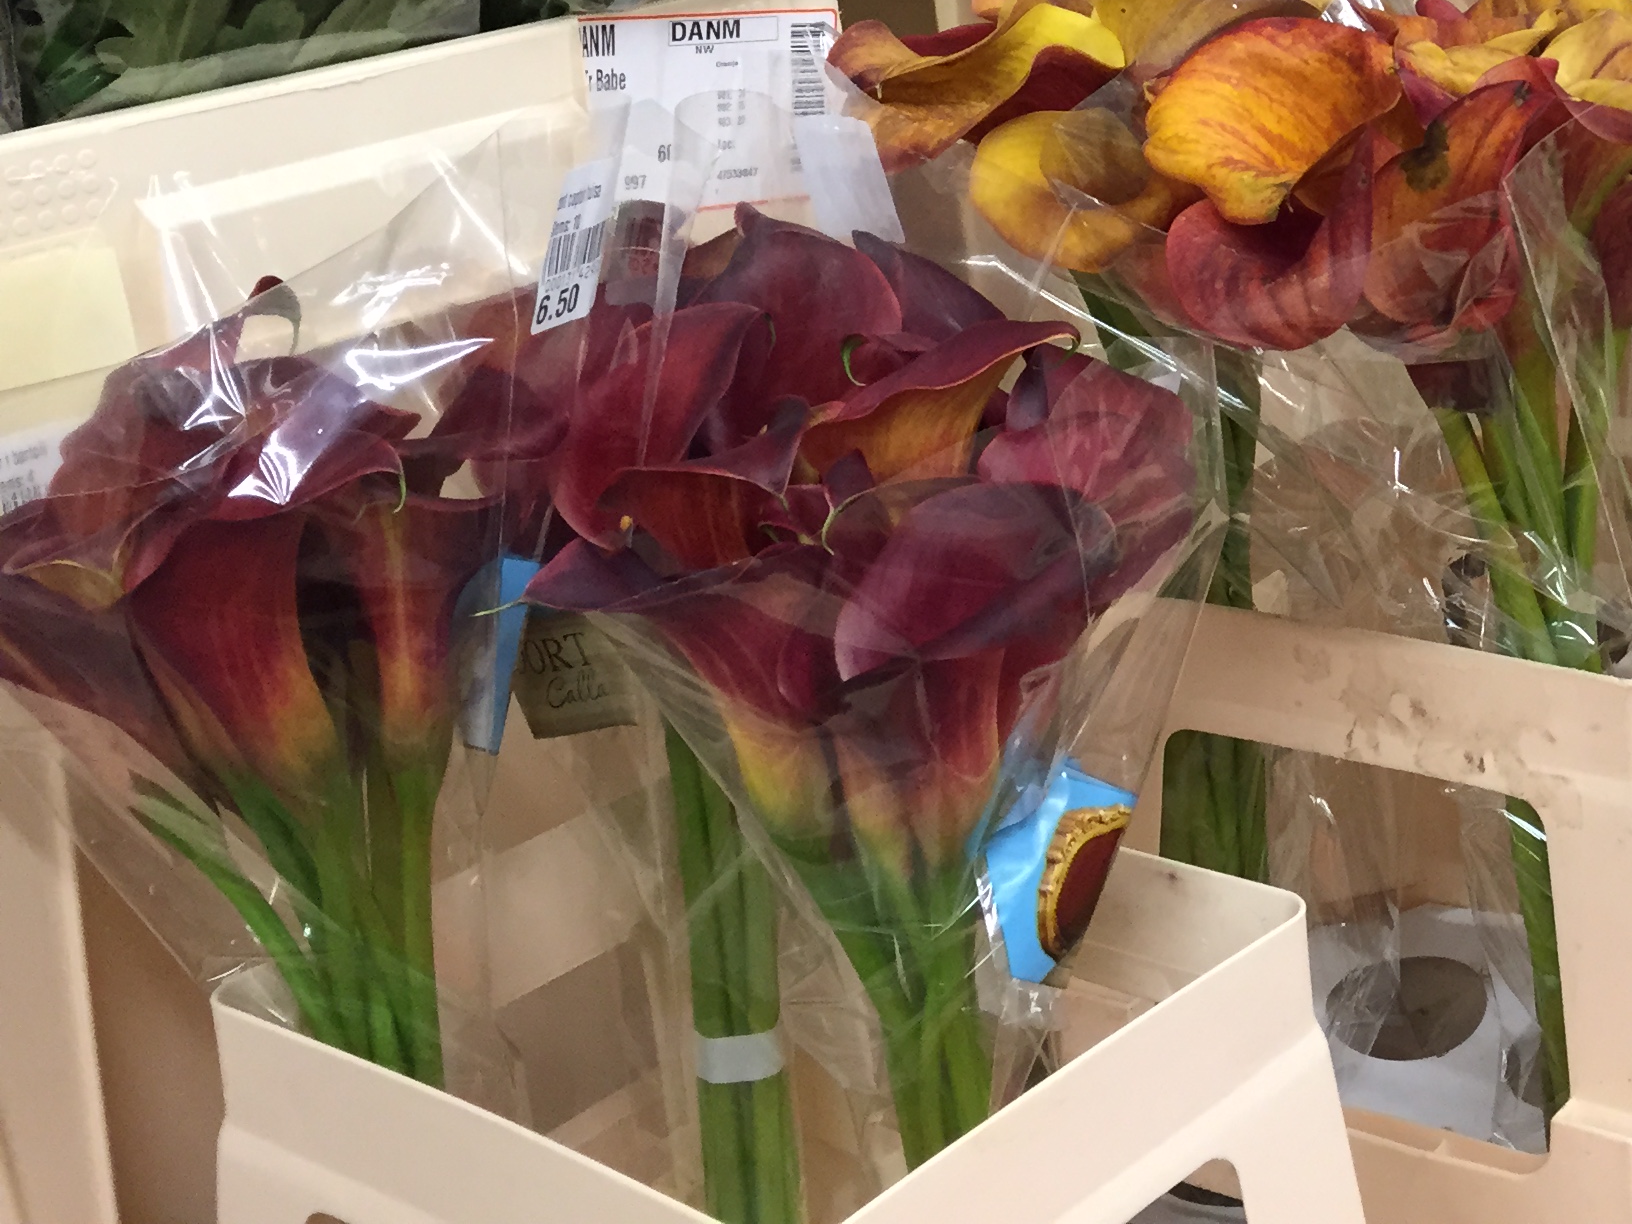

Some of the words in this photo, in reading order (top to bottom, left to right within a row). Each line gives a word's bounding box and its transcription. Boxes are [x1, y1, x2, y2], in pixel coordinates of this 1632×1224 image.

[579, 24, 616, 58] ANM
[671, 19, 741, 42] DANM
[695, 45, 714, 55] NW
[596, 68, 627, 92] Babe
[536, 283, 580, 325] 6.50
